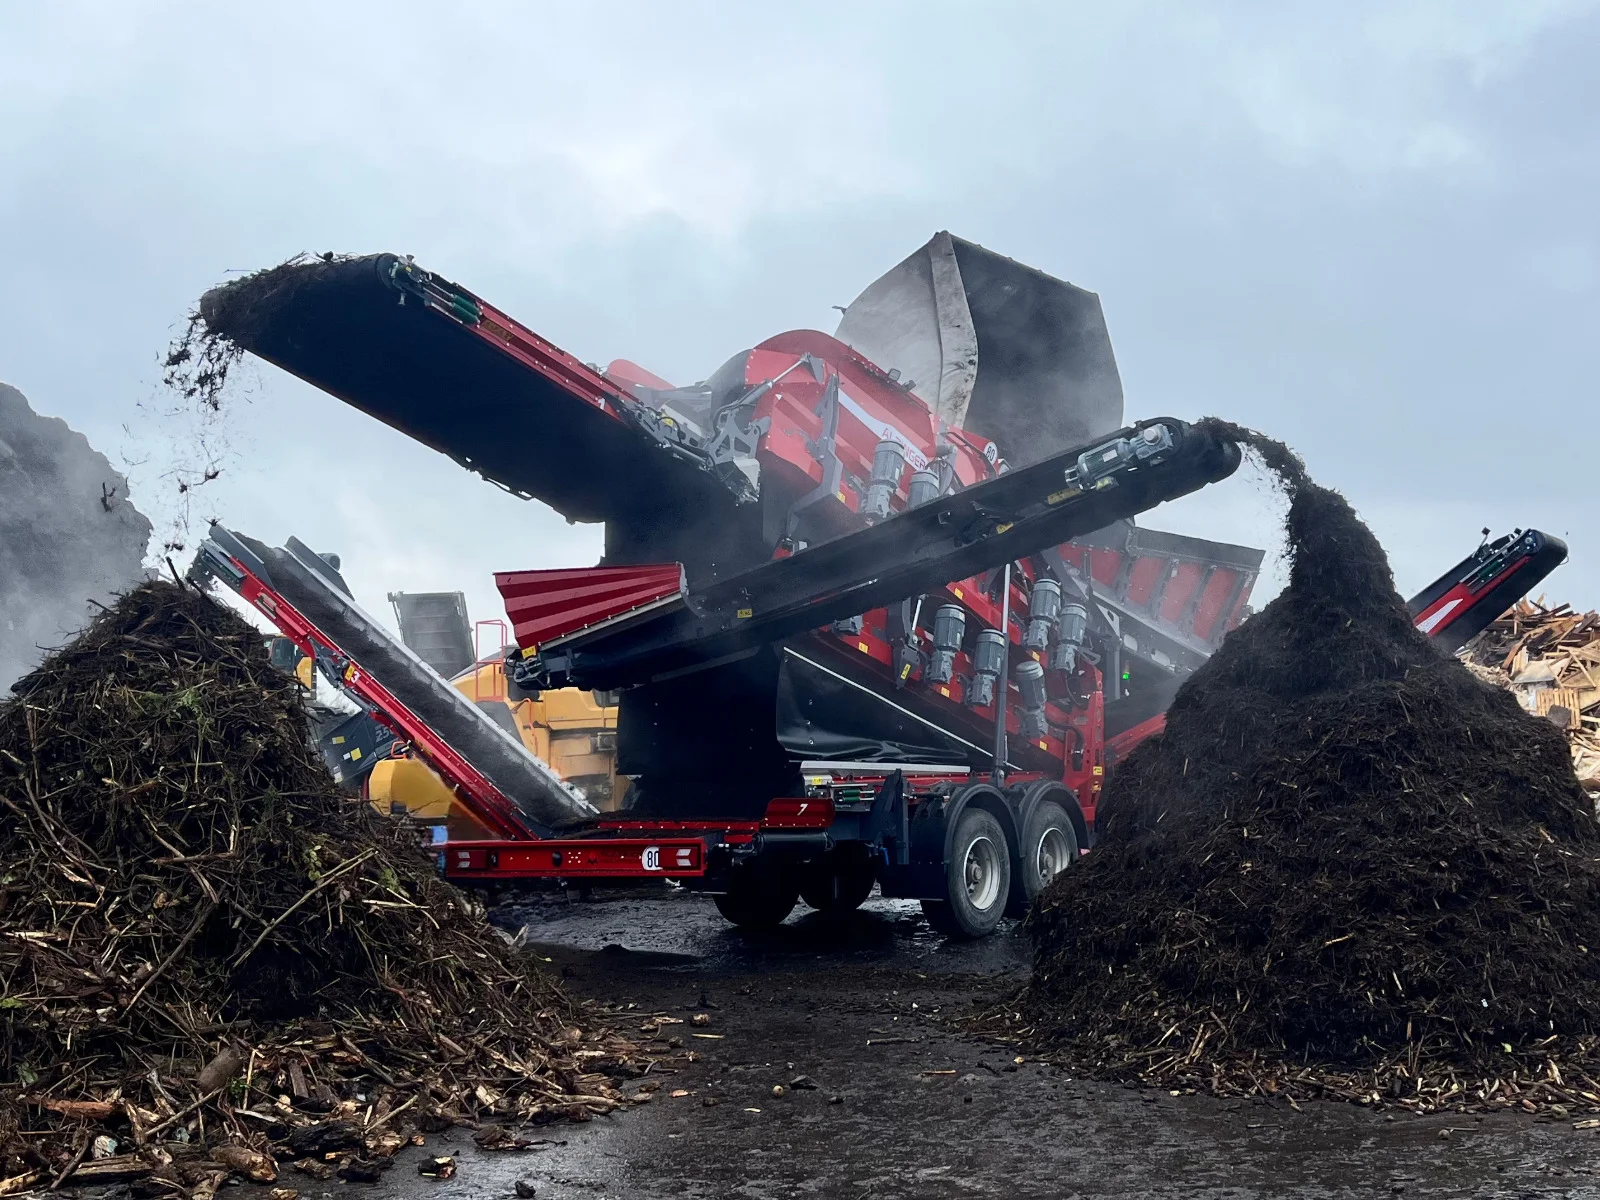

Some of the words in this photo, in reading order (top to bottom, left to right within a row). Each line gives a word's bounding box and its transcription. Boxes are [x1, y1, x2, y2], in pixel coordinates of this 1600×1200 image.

[881, 428, 926, 470] ALNGER
[985, 445, 996, 461] 80
[350, 670, 361, 684] 3
[797, 803, 808, 816] 7
